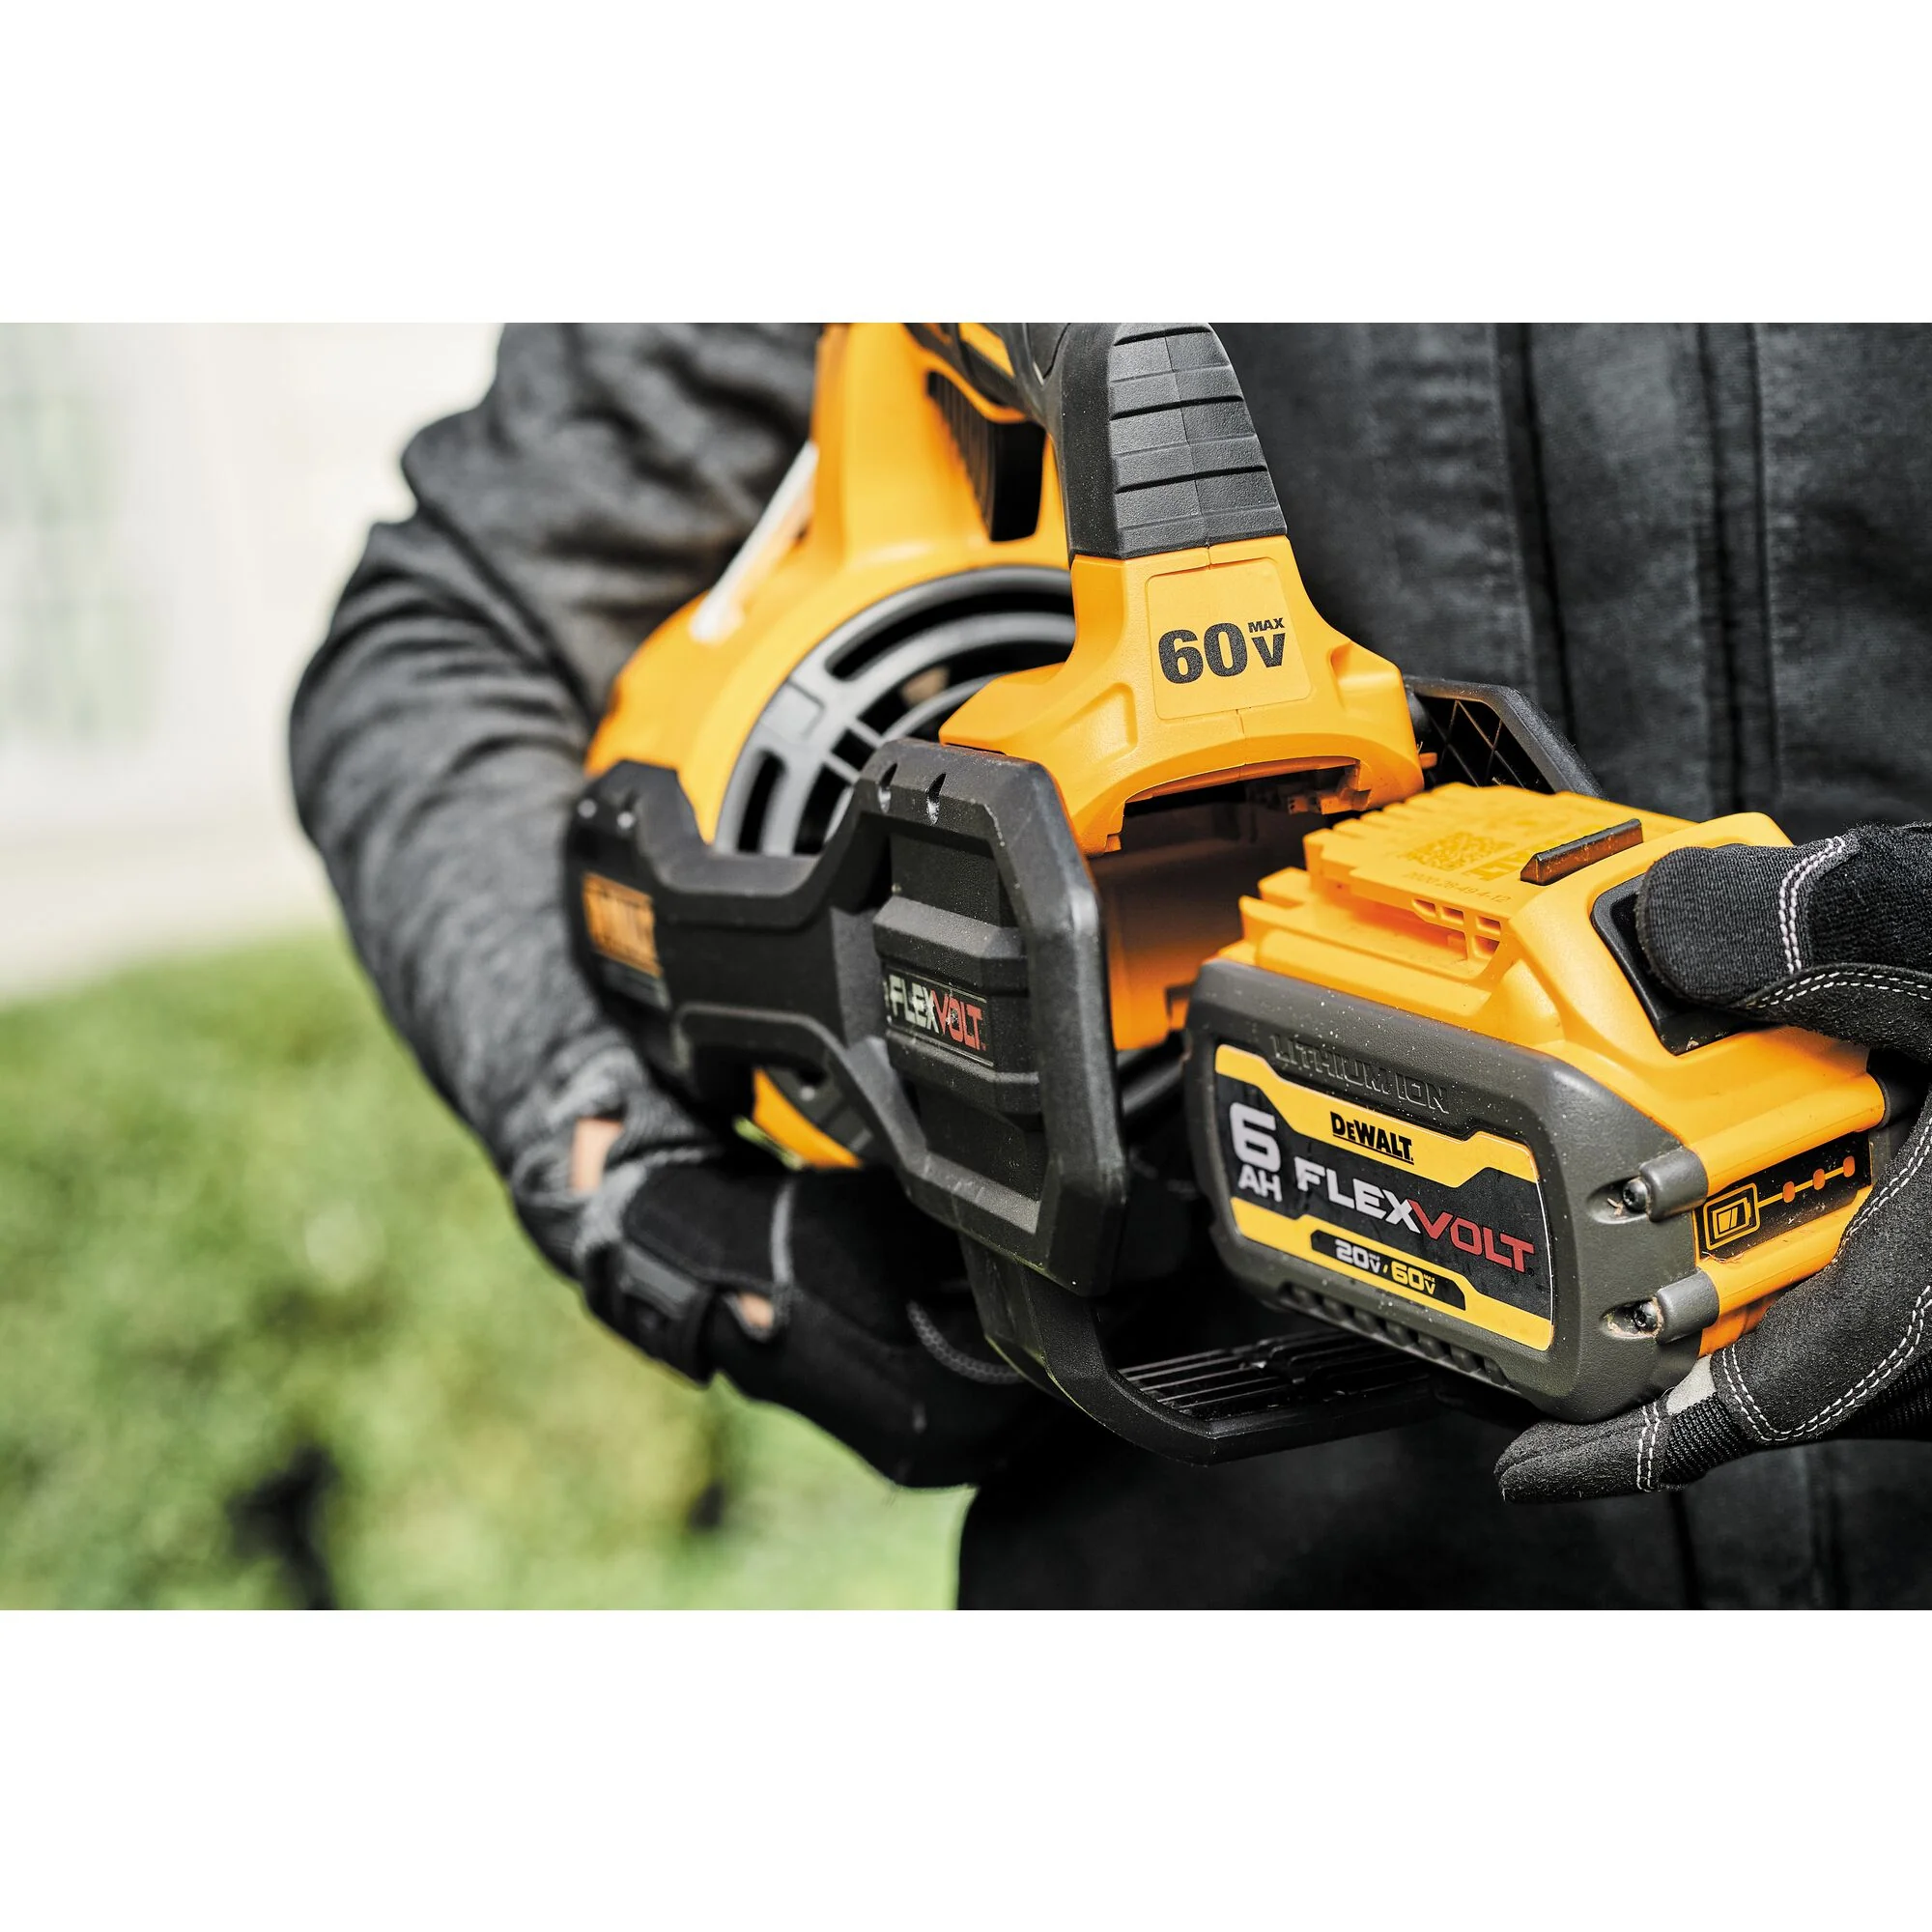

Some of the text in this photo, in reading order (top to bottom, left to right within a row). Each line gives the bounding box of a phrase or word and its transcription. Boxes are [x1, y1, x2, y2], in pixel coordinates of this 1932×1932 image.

[1158, 617, 1286, 684] 60V MAX
[889, 974, 983, 1051] FLEXVOLT
[1269, 1034, 1450, 1114] LITHIUM ION
[1230, 1101, 1282, 1173] 6
[1237, 1164, 1283, 1203] AH
[1293, 1155, 1535, 1274] FLEXVOLT
